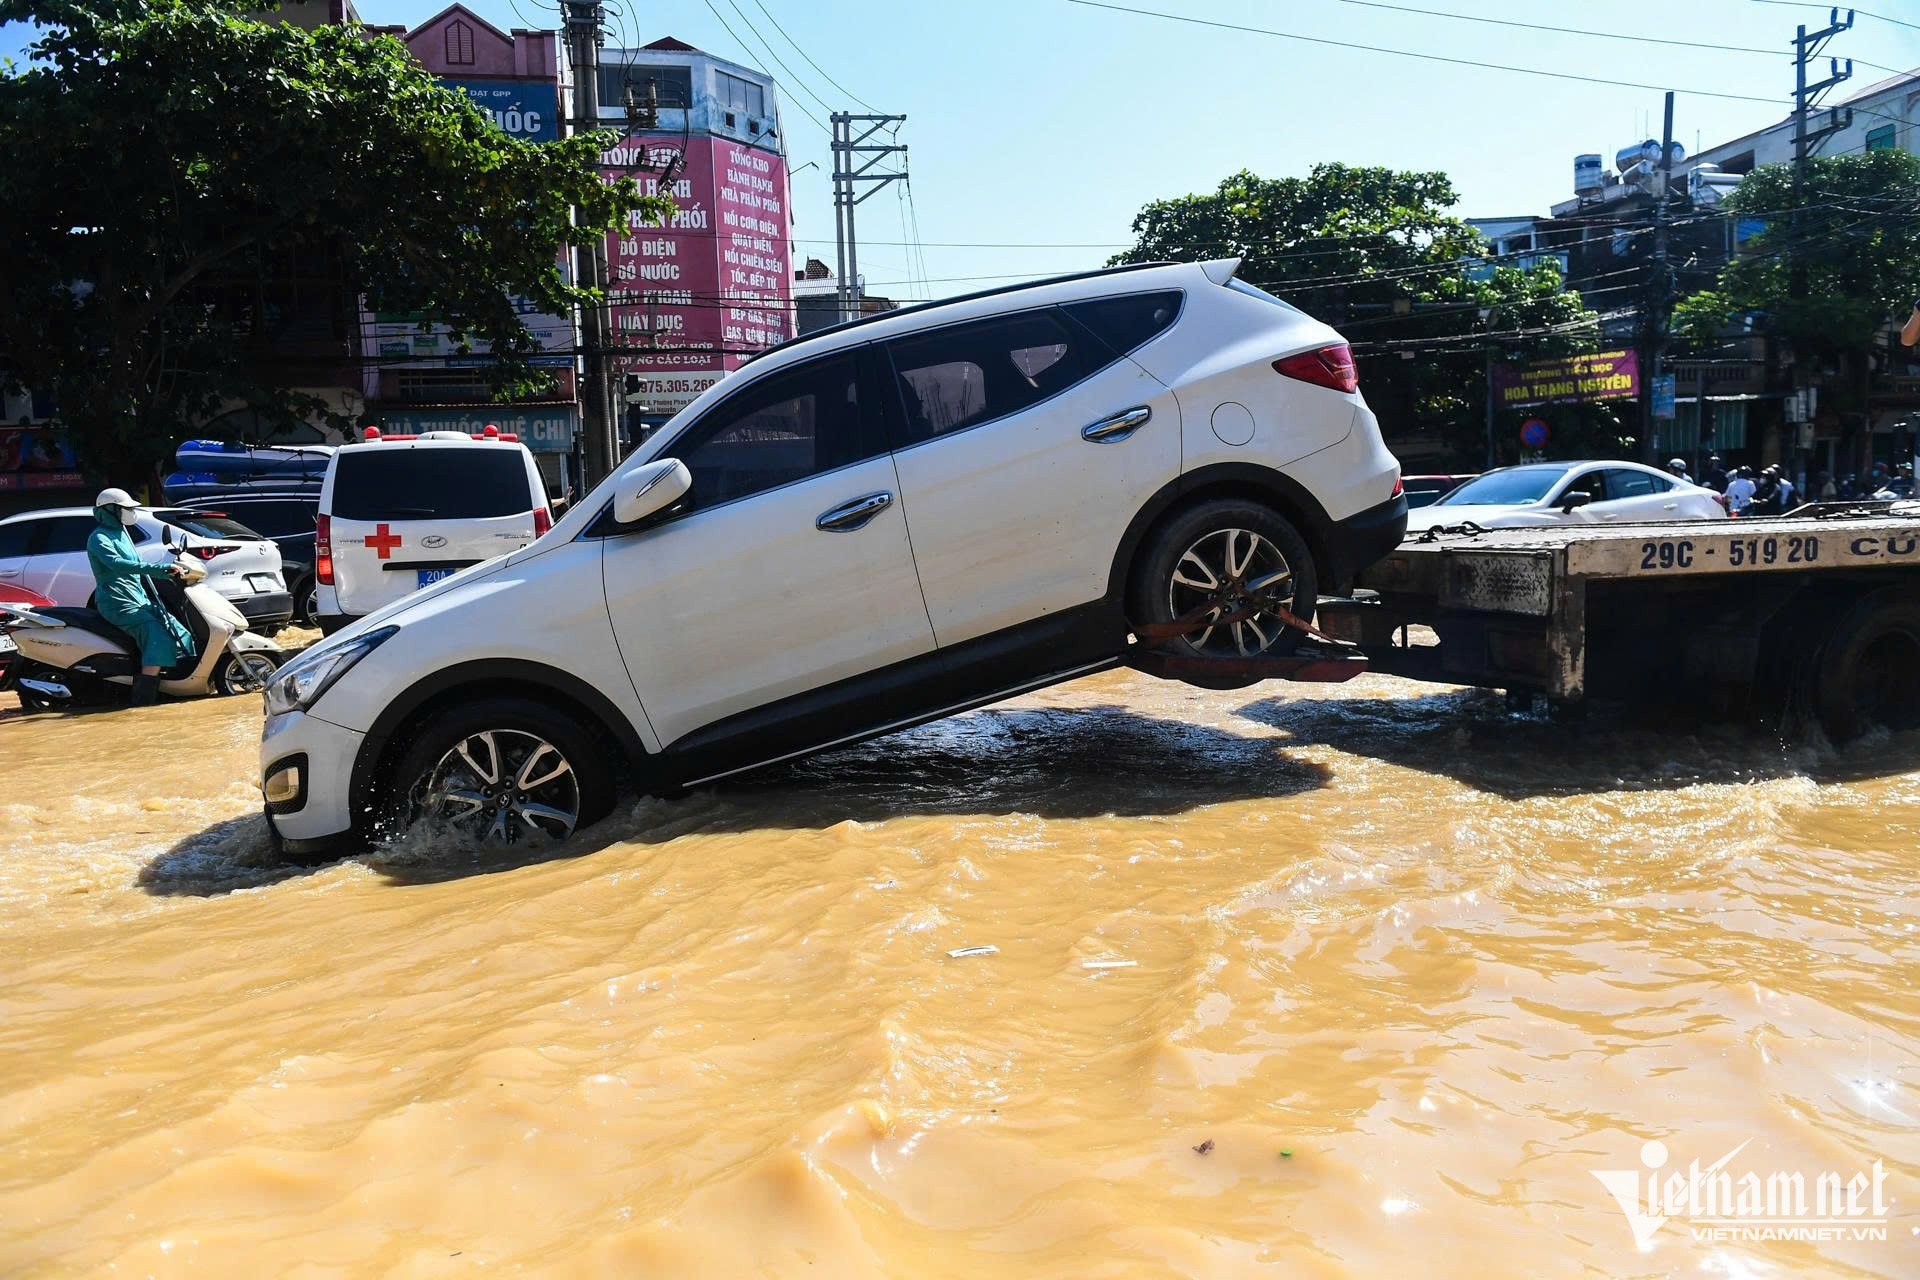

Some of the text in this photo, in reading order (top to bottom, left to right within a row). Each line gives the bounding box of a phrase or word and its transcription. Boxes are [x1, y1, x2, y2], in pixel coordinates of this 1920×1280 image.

[752, 156, 769, 173] KHO
[721, 186, 739, 203] NHÀ
[670, 202, 708, 229] PHỐI
[641, 238, 677, 260] ĐIỆN
[640, 262, 680, 280] NƯỚC
[656, 354, 681, 364] CÁC
[1504, 386, 1530, 401] HOA
[532, 420, 566, 440] CHI
[1641, 541, 1693, 569] 29C
[1729, 538, 1778, 567] 519
